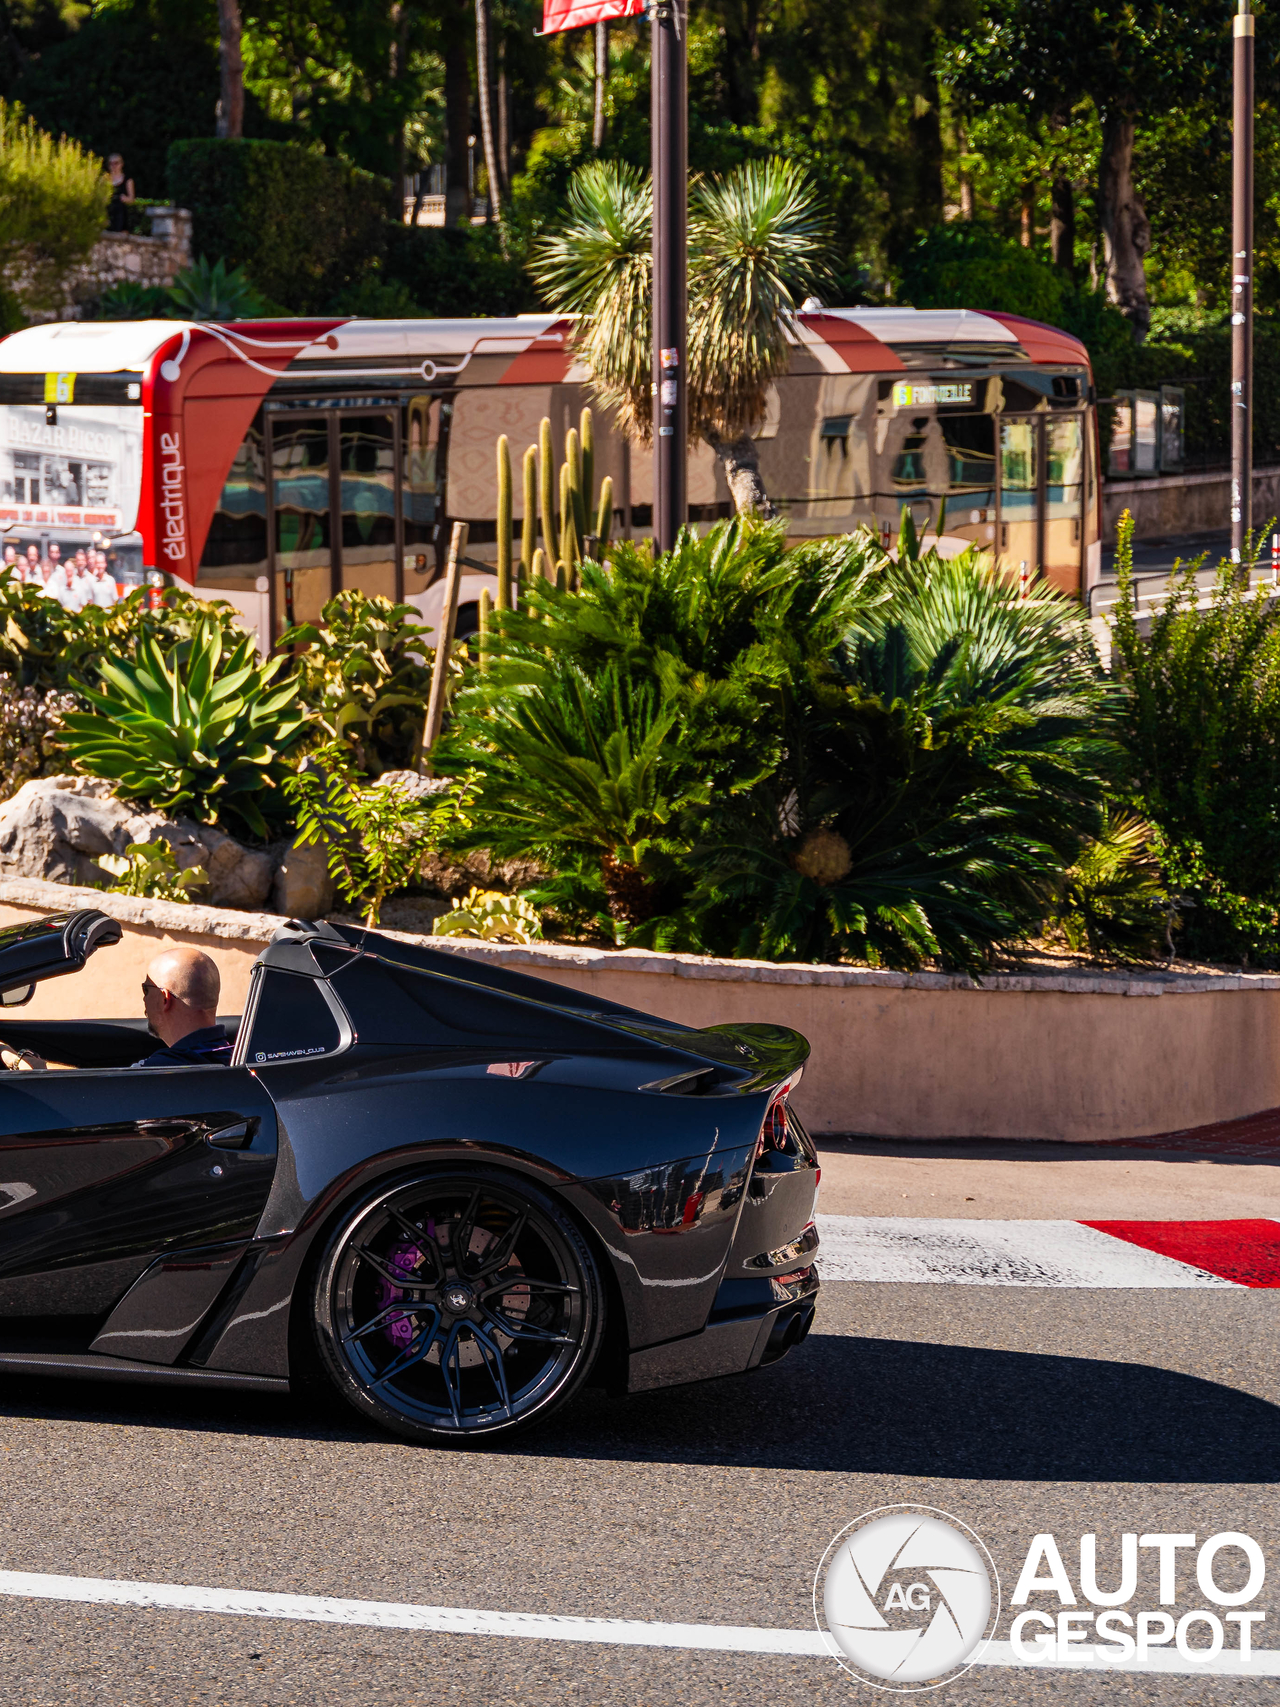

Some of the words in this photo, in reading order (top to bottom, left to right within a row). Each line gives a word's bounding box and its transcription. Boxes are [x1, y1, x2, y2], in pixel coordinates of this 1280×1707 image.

[56, 373, 69, 402] 6
[8, 416, 65, 449] BAZAR
[160, 432, 186, 560] électrique
[560, 1216, 591, 1267] MICHELIN
